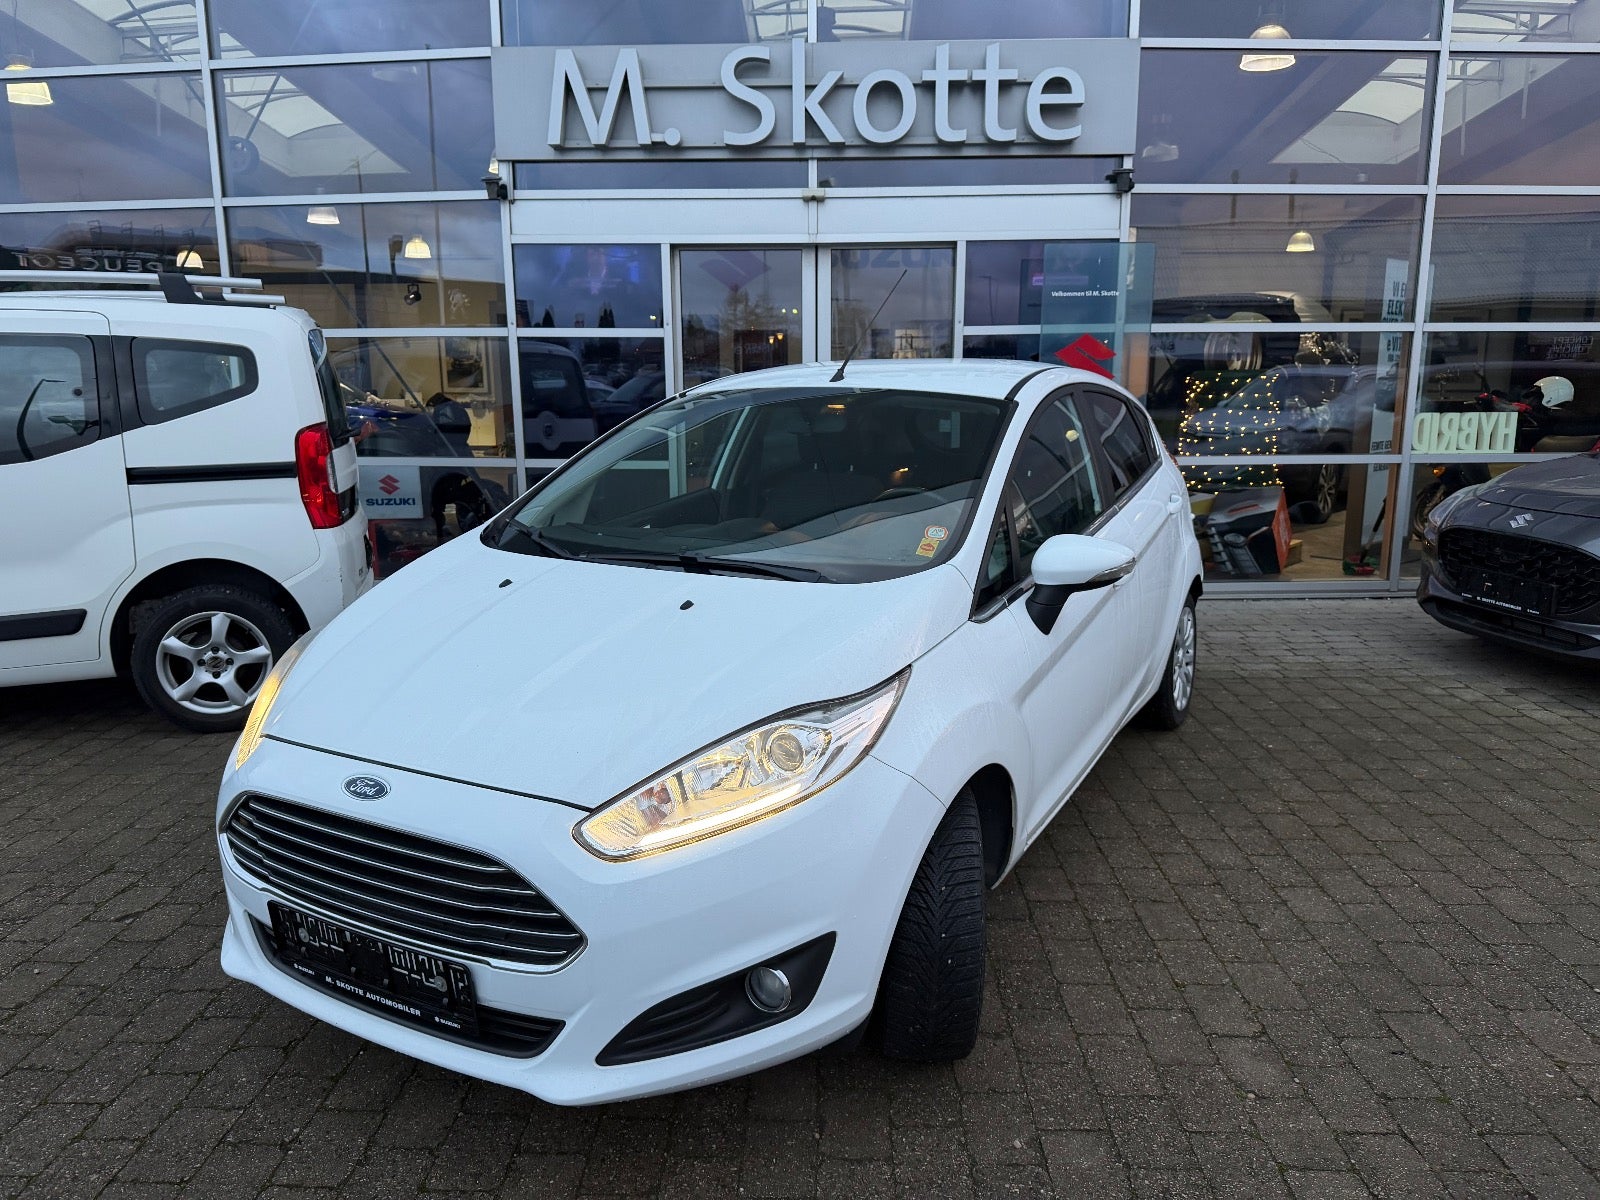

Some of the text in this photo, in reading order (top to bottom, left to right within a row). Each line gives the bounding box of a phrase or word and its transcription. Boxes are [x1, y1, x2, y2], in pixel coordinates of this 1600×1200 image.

[548, 37, 1086, 149] M. Skotte
[366, 497, 416, 506] SUZUKI
[350, 779, 380, 796] Ford
[325, 975, 421, 1017] M. SKOTTE AUTOMOBILER
